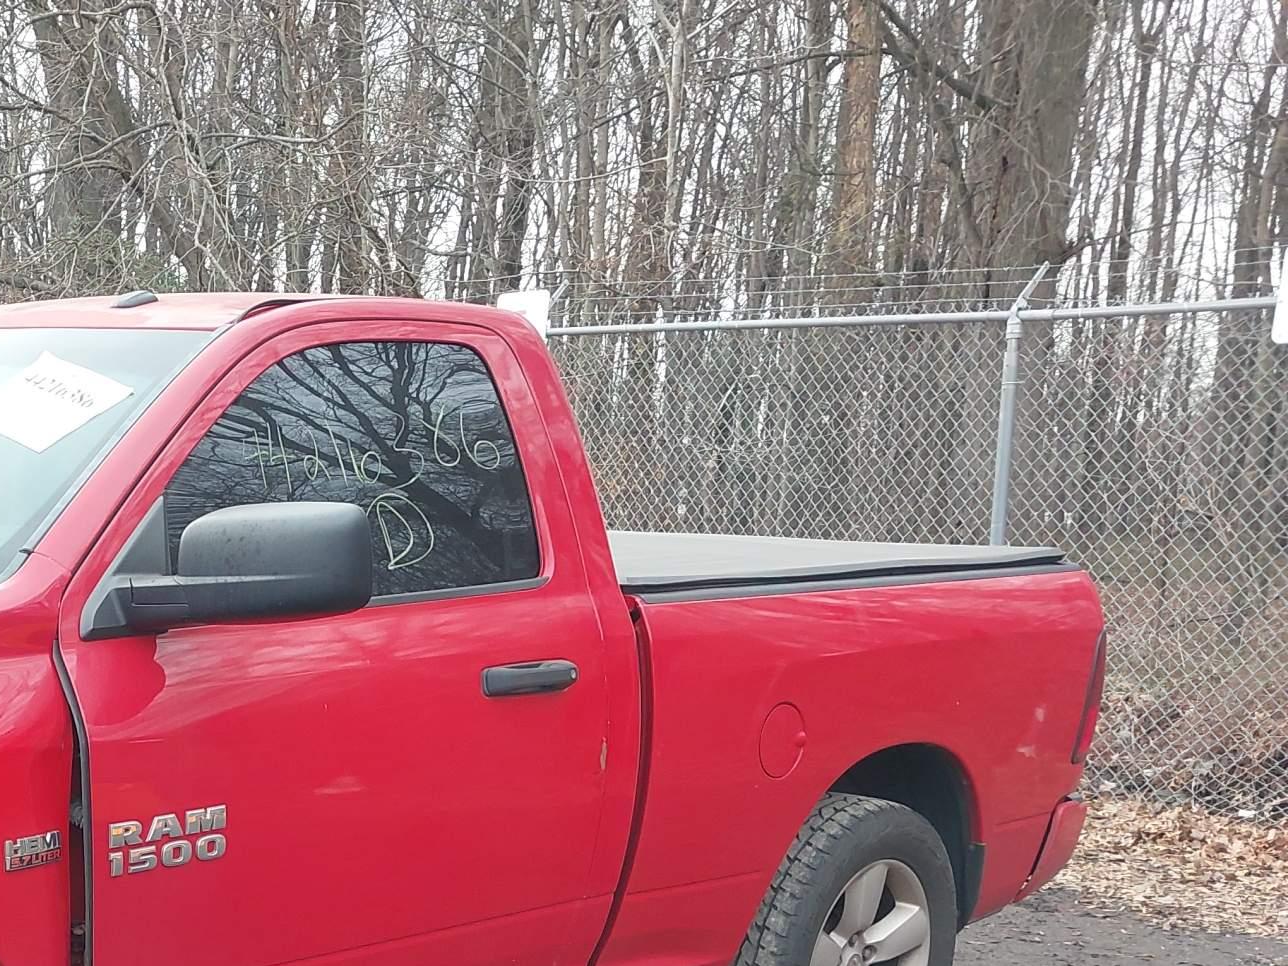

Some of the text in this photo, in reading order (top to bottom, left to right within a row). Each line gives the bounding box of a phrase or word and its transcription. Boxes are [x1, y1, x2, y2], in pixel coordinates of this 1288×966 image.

[5, 831, 62, 857] HEMI
[108, 804, 228, 849] RAM
[108, 833, 228, 878] 1500
